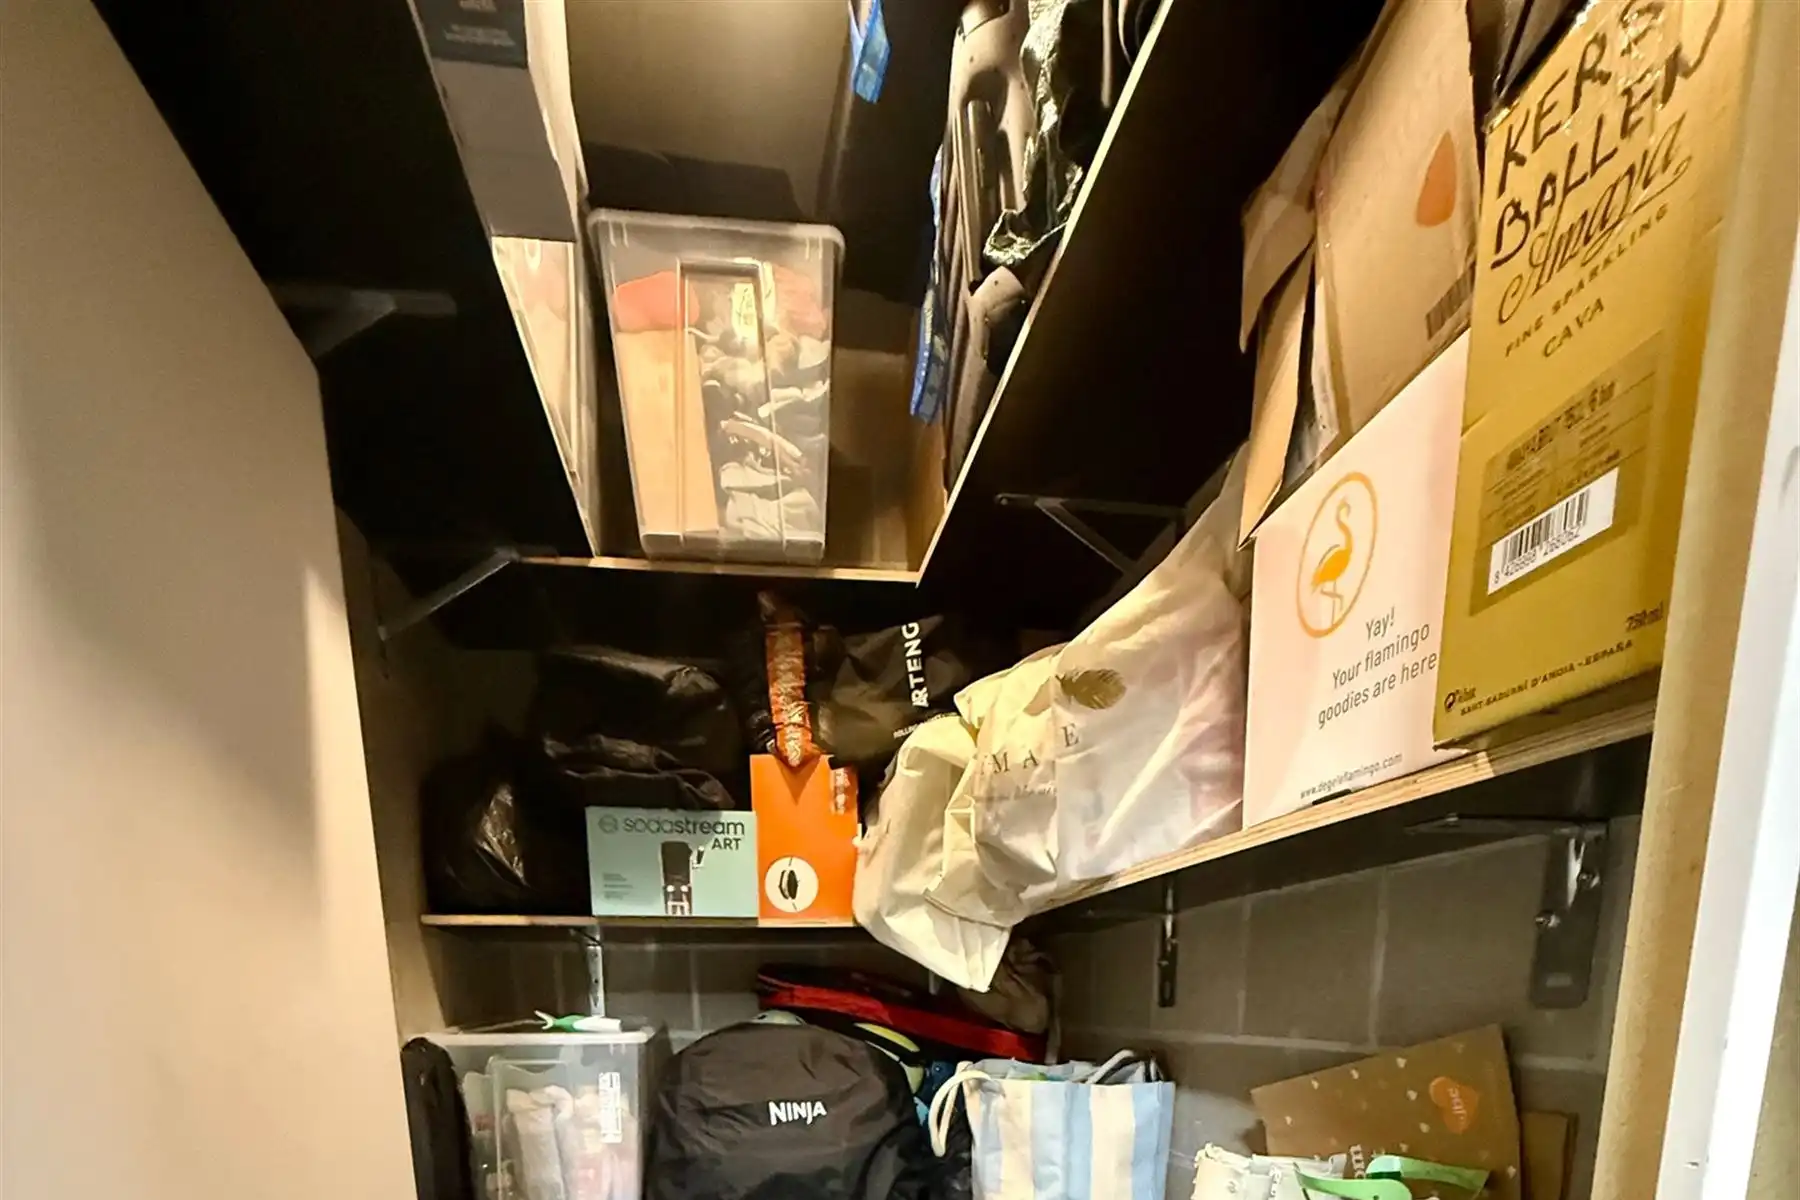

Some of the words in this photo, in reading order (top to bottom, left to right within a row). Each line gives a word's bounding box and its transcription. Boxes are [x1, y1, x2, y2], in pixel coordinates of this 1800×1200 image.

[1490, 0, 1725, 270] BALLEN
[1506, 313, 1545, 358] FINE
[1551, 202, 1669, 316] SPARKLING
[1542, 297, 1605, 358] CAVA
[1365, 605, 1396, 643] Yay!
[1331, 660, 1362, 691] Your
[1364, 622, 1431, 673] flamingo
[1317, 686, 1370, 731] goodies
[1372, 672, 1397, 699] are
[1400, 652, 1438, 686] here
[623, 815, 745, 836] sodastream
[711, 837, 742, 851] ART
[768, 1100, 828, 1127] NINJA
